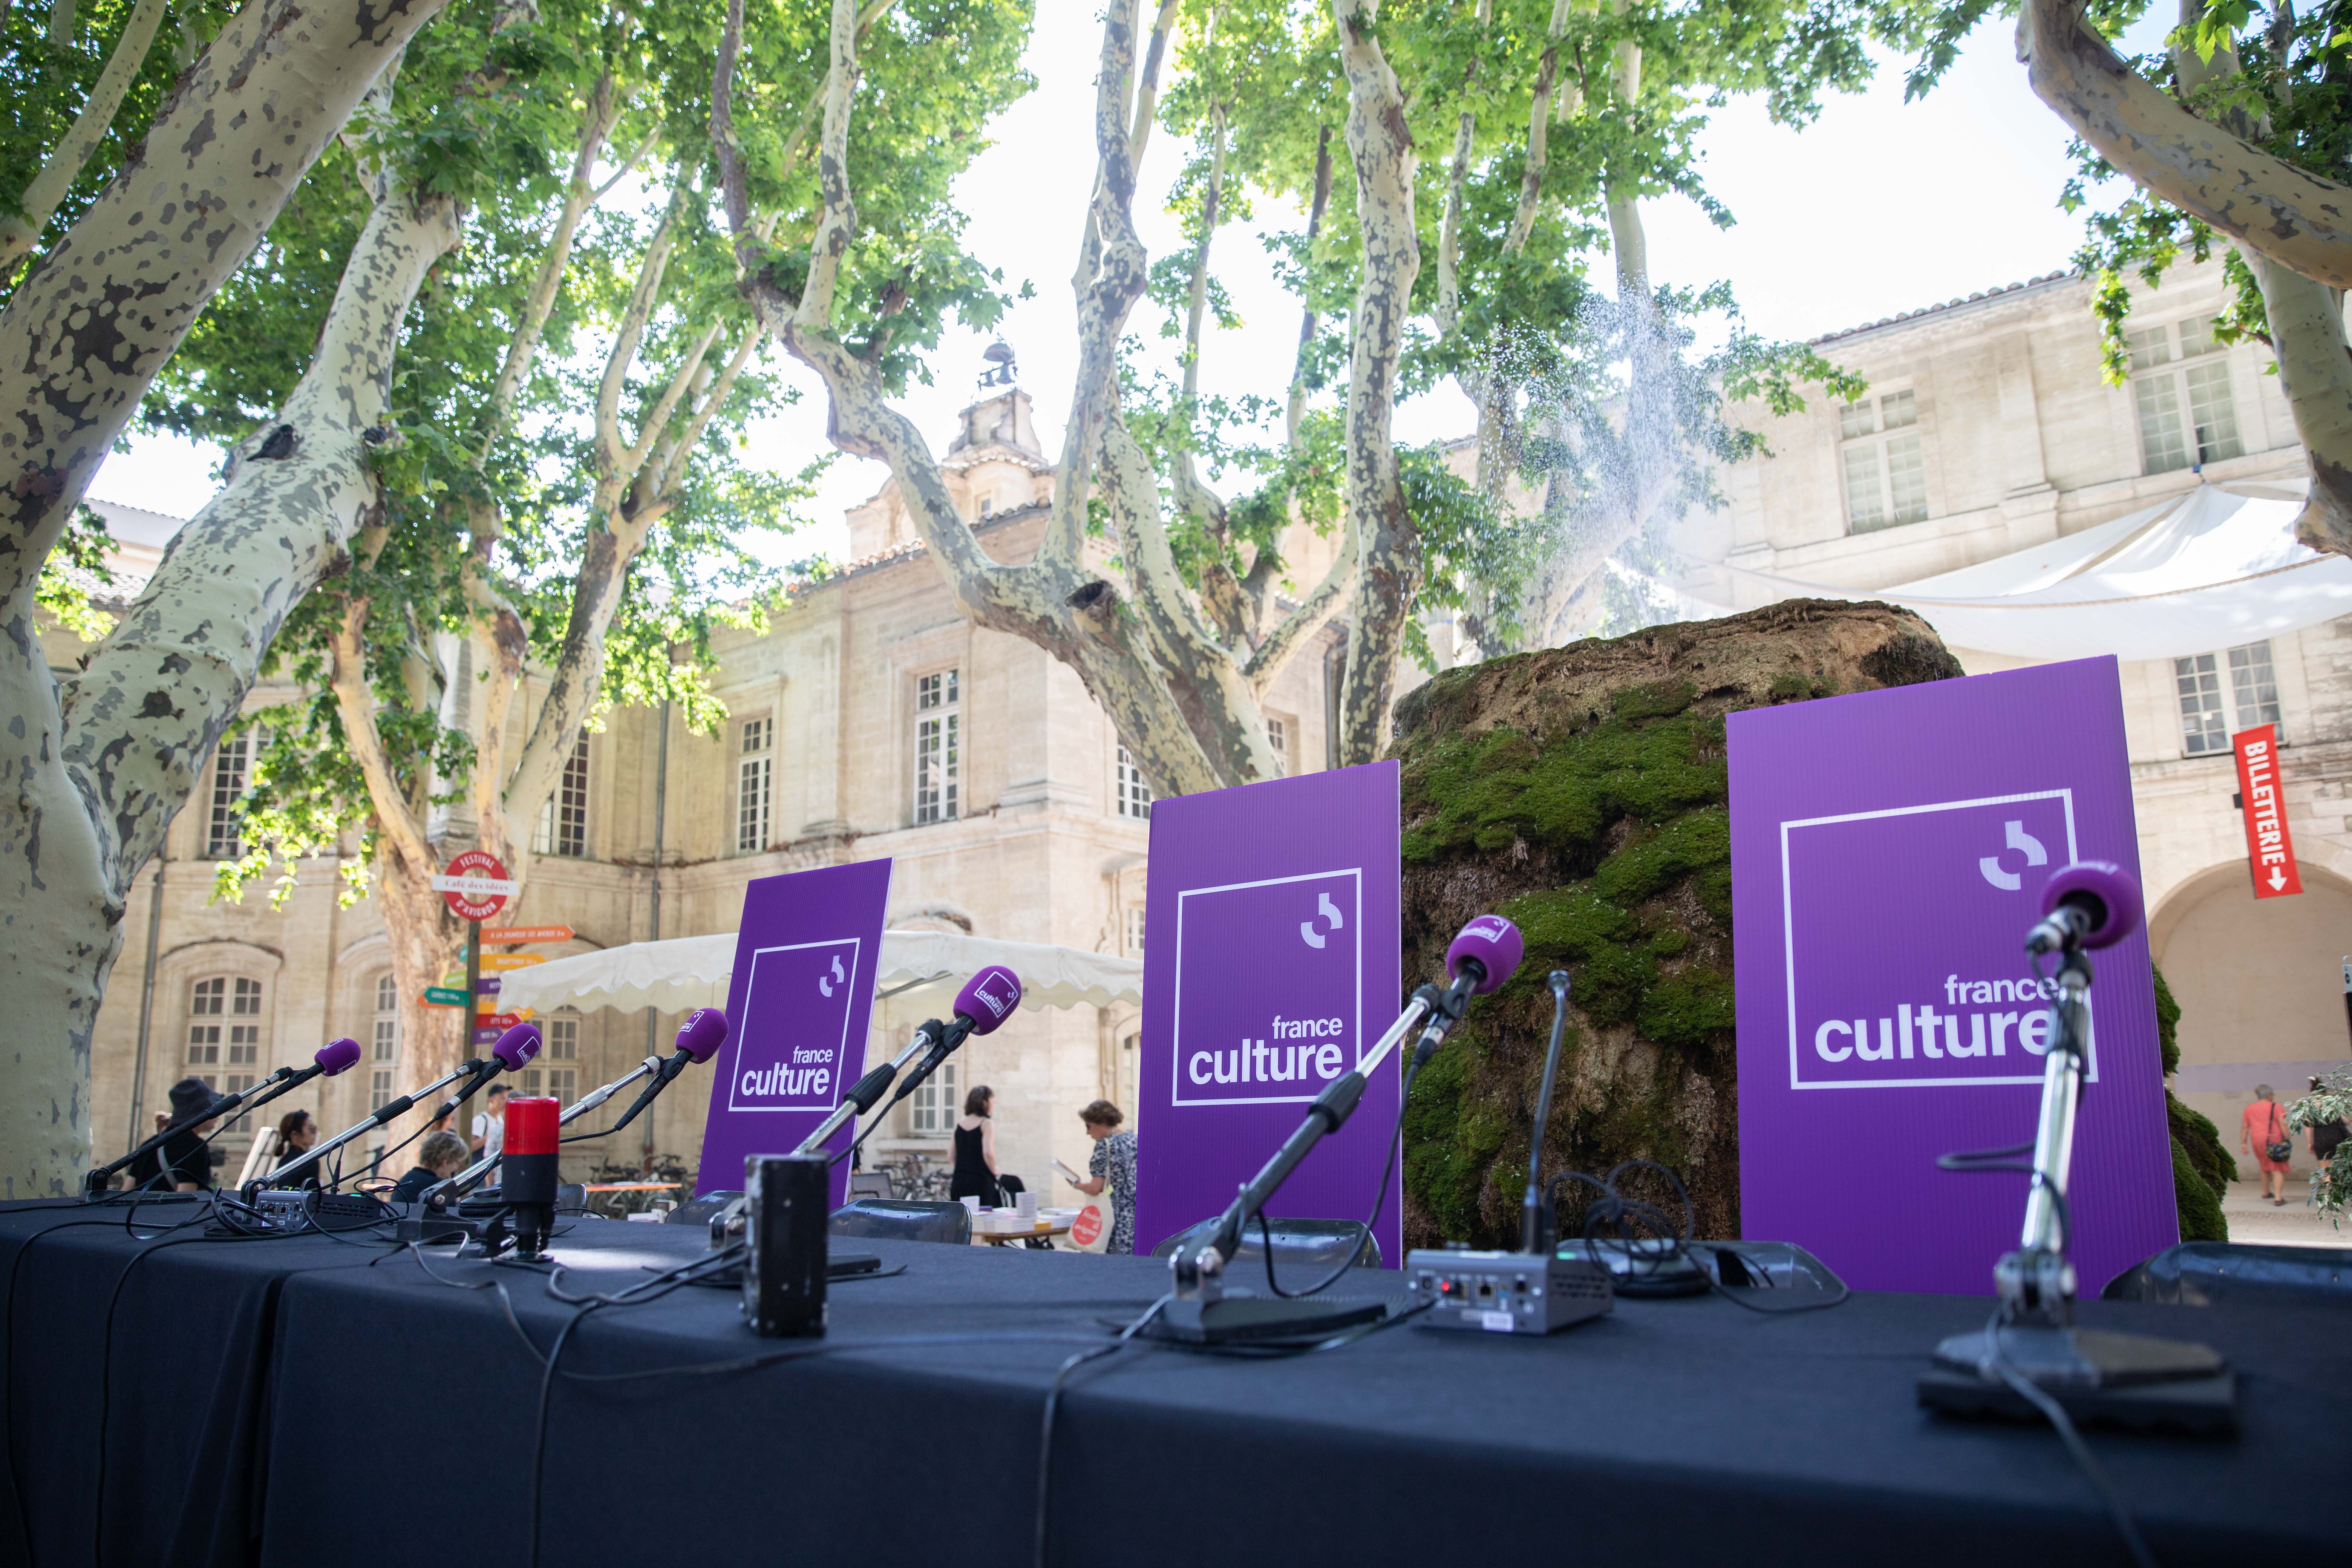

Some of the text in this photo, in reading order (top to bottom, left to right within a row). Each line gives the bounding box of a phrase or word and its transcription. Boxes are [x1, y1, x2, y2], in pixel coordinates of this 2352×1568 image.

[2244, 740, 2286, 866] BILLETTERIE
[459, 854, 495, 870] FESTIVAL
[445, 880, 509, 891] Café des idées
[455, 898, 497, 917] D'AVIGNON
[979, 990, 1002, 1013] culture
[1944, 975, 2059, 1005] france
[1272, 1015, 1343, 1040] france
[1815, 1003, 2050, 1063] culture
[793, 1046, 833, 1064] france
[1189, 1038, 1343, 1085] culture
[741, 1062, 830, 1096] culture
